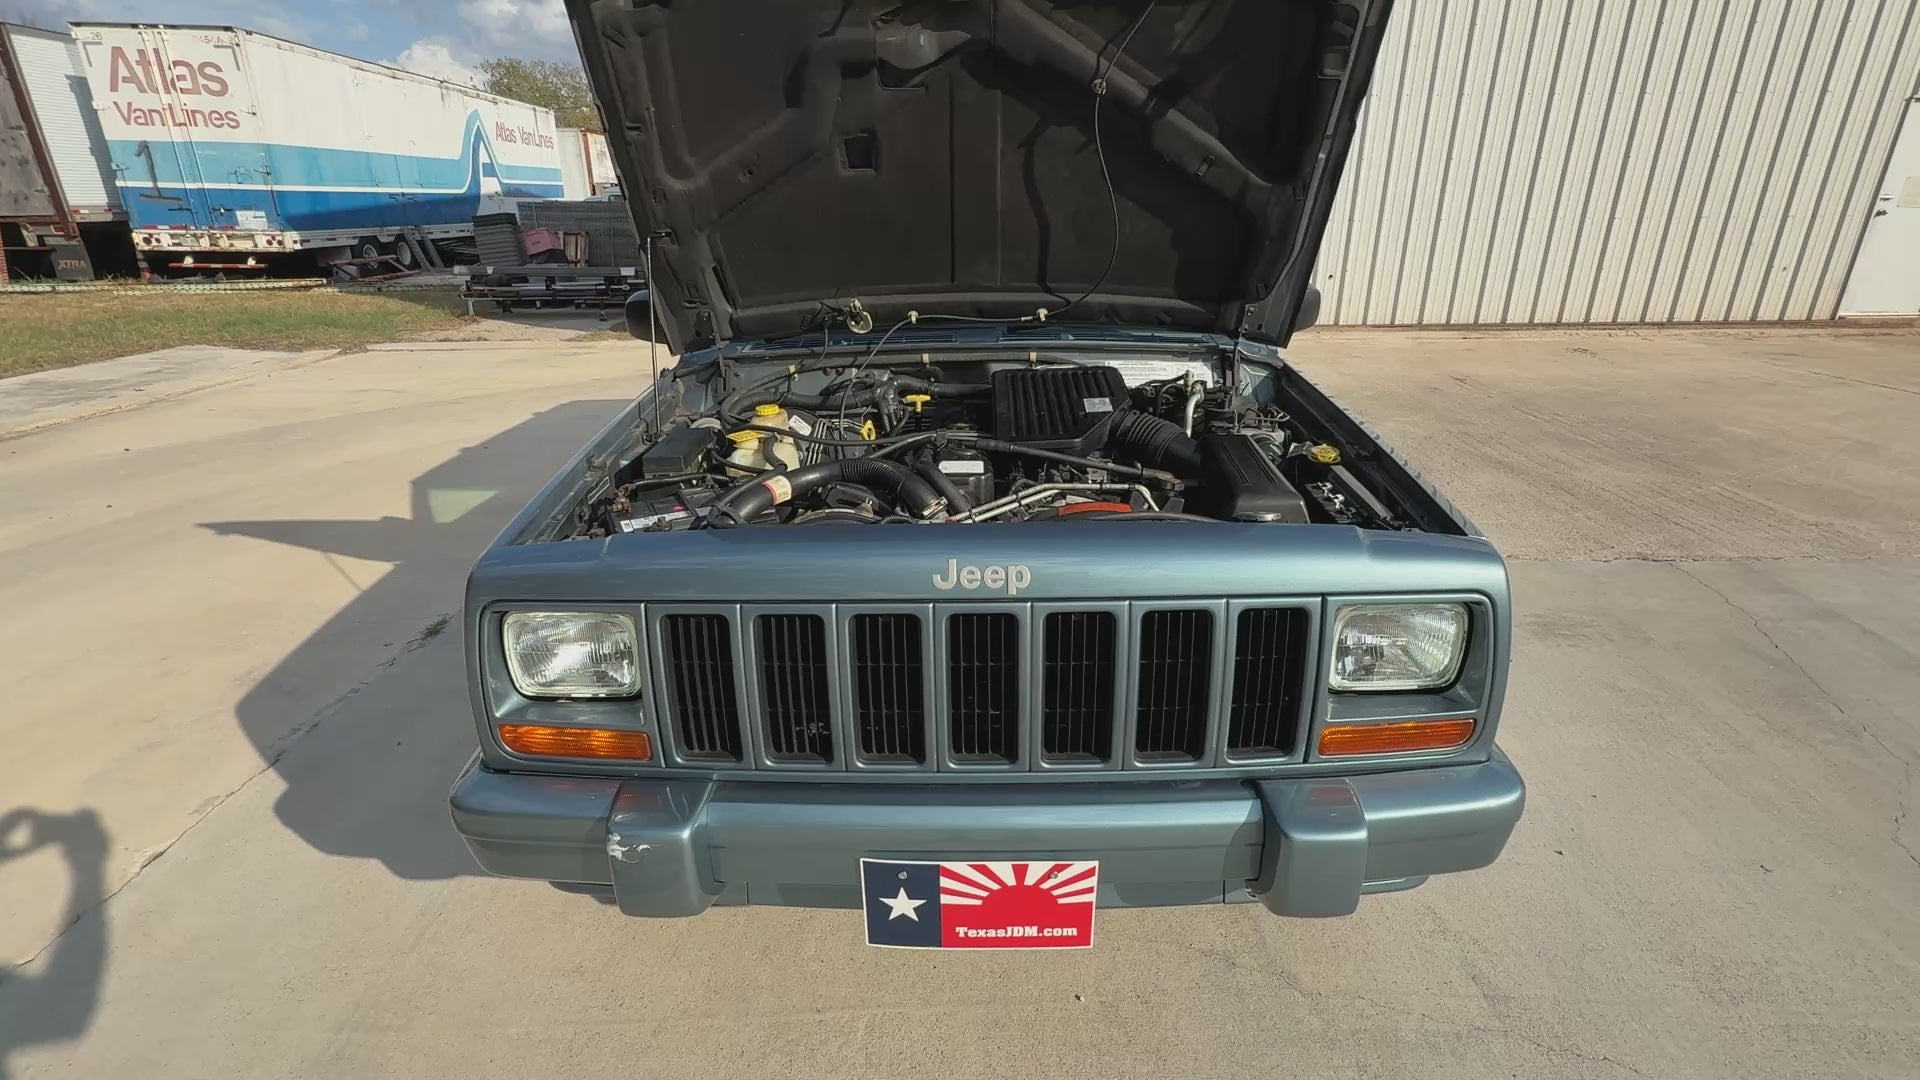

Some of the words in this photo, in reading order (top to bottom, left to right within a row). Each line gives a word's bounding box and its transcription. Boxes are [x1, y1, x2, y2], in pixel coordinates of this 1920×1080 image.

[110, 46, 229, 97] Atlas
[496, 121, 517, 144] Atlas
[57, 259, 88, 270] XTRA
[932, 558, 1031, 595] Jeep
[955, 925, 1078, 939] TexasJDM.com
